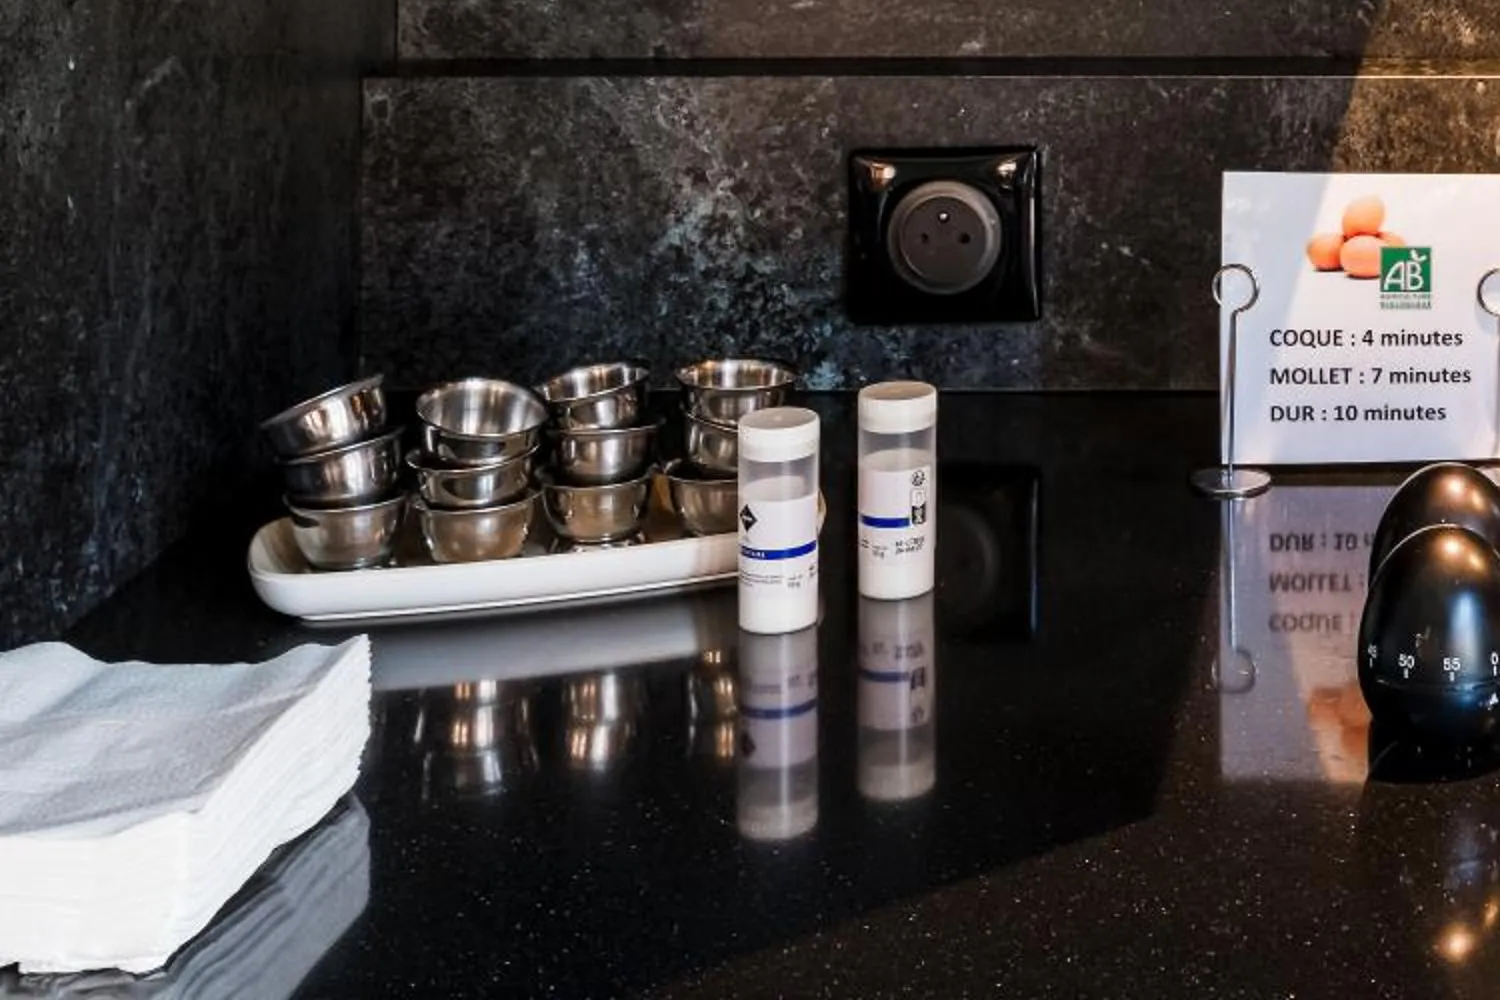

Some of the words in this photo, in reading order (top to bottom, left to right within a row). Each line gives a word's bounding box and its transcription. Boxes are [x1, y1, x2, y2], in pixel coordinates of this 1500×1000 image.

[1383, 259, 1424, 291] AB
[1269, 329, 1344, 348] COQUE
[1361, 329, 1374, 347] 4
[1381, 329, 1463, 347] minutes
[1270, 367, 1353, 385] MOLLET
[1371, 367, 1383, 384] 7
[1388, 367, 1472, 384] minutes
[1270, 405, 1315, 422] DUR
[1334, 405, 1358, 421] 10
[1363, 404, 1447, 421] minutes
[1398, 654, 1415, 669] 50
[1443, 657, 1461, 671] 55
[1490, 651, 1500, 665] 0
